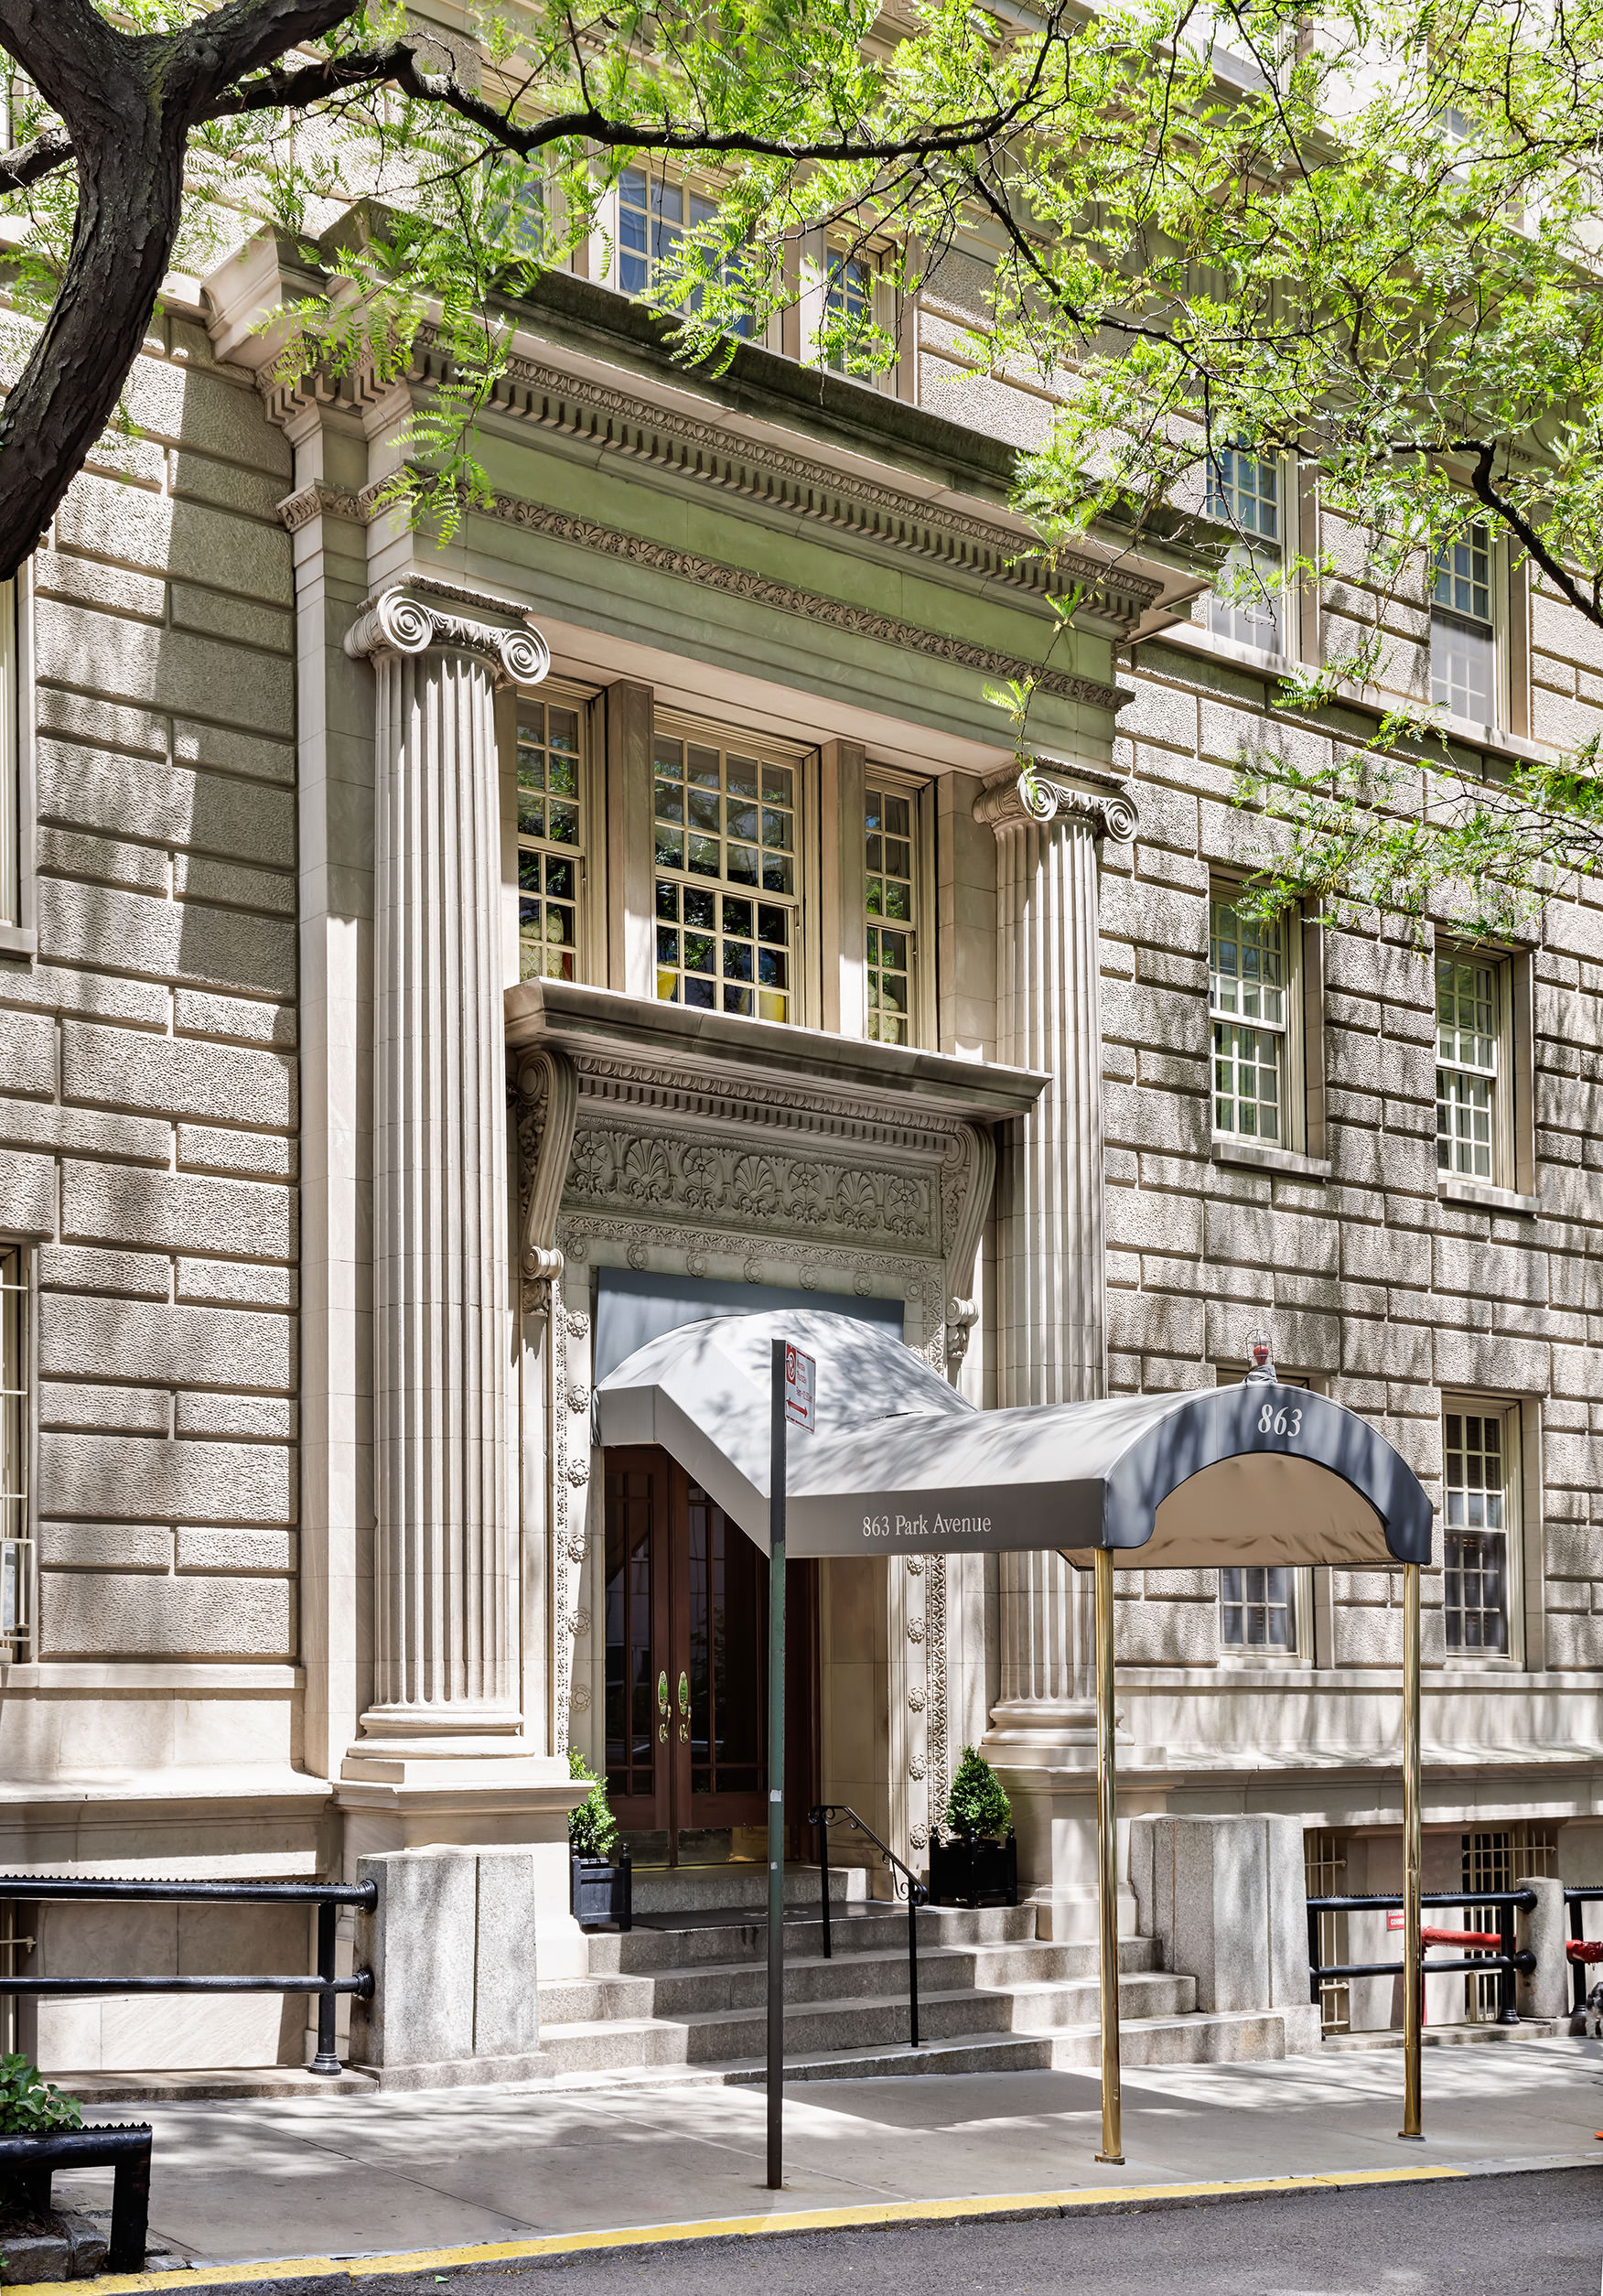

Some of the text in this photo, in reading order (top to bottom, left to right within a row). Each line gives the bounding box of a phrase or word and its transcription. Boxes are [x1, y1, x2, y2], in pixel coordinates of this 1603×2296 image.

[1257, 1404, 1303, 1437] 863
[862, 1513, 992, 1537] 863 Park Avenue
